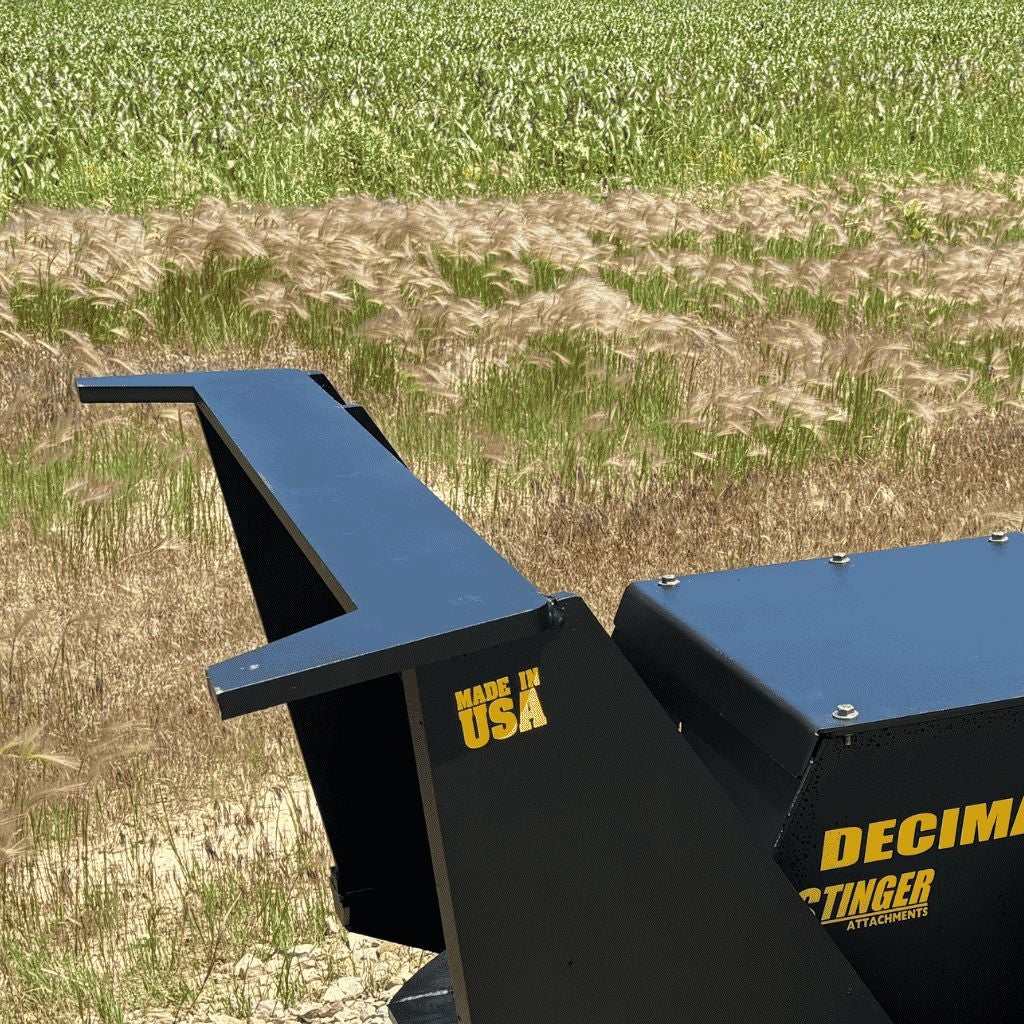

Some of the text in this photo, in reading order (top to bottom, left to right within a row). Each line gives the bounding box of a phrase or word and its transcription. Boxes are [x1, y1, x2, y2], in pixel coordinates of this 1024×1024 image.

[454, 667, 541, 711] MADE IN
[458, 687, 548, 750] USA
[847, 906, 929, 931] ATTACHMENTS
